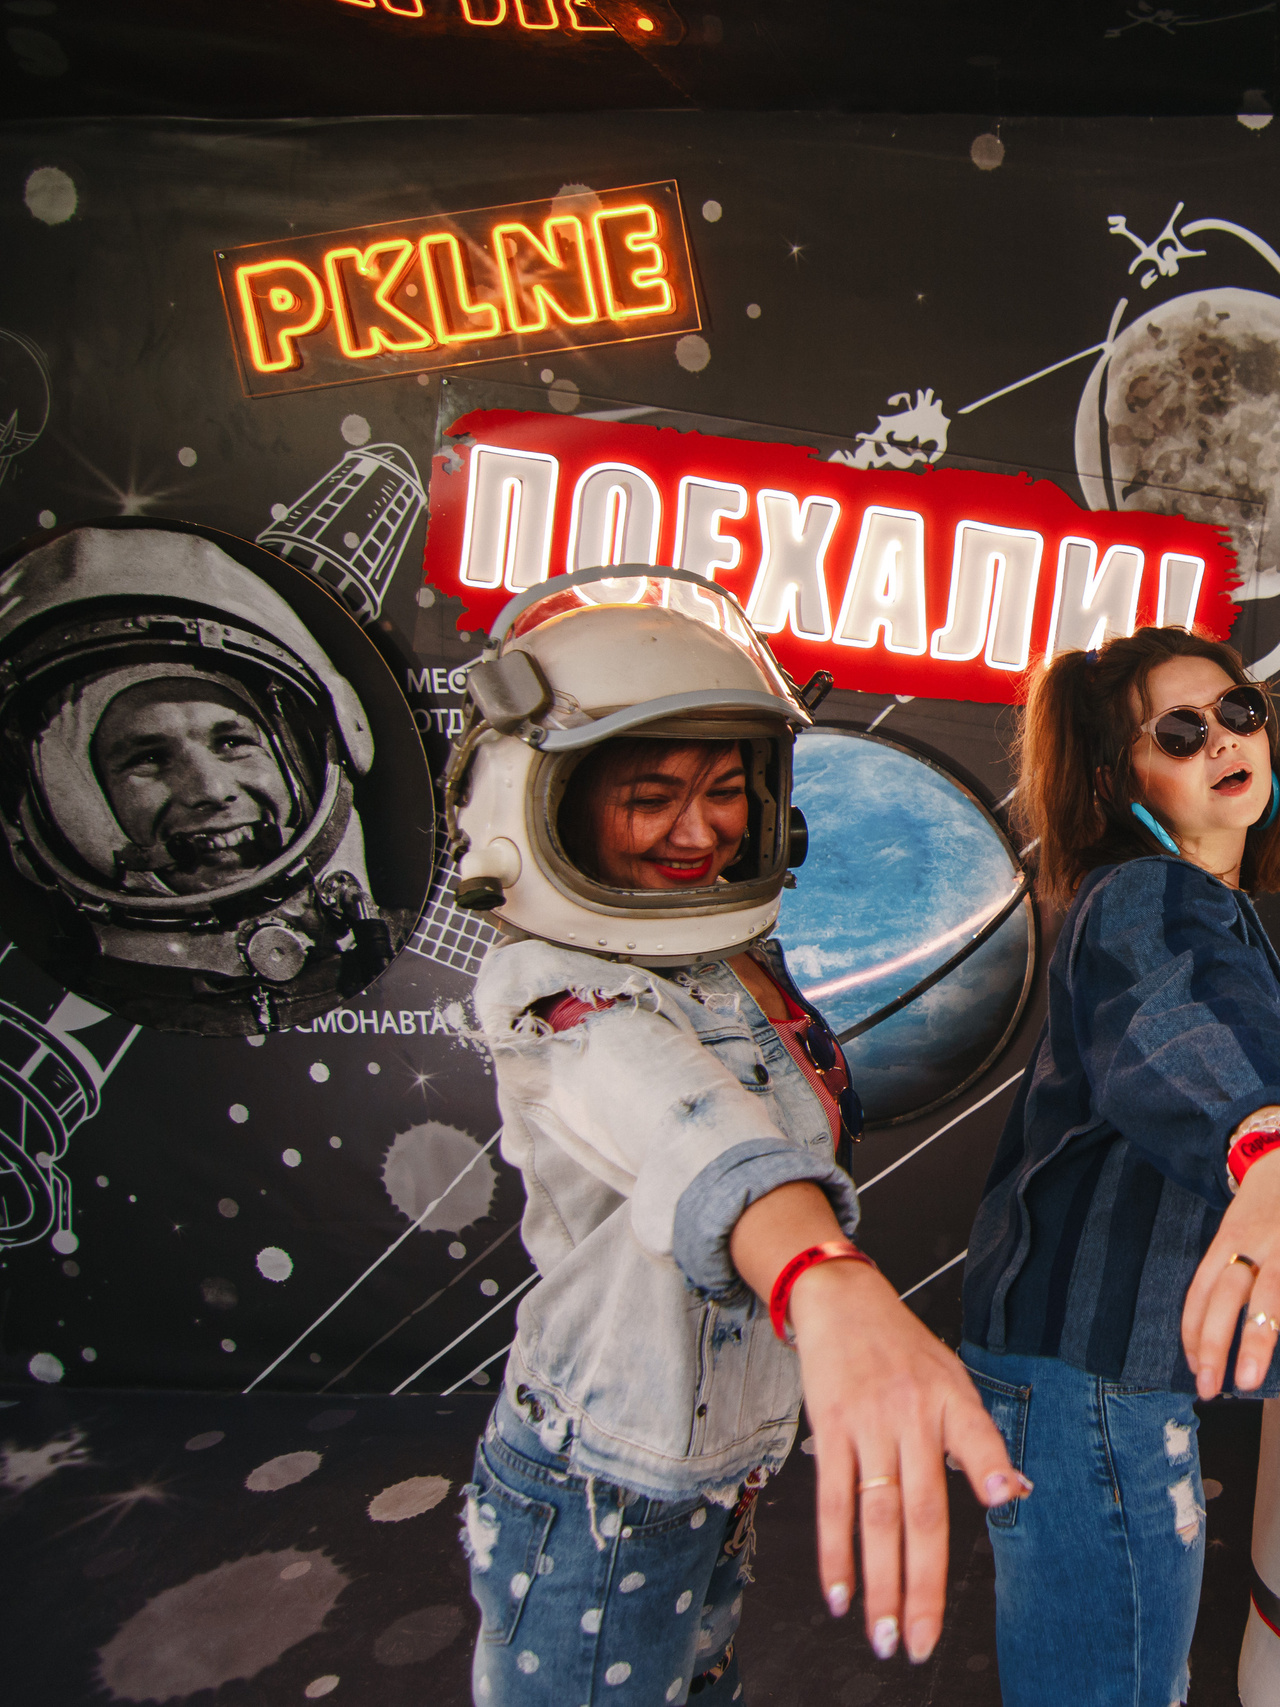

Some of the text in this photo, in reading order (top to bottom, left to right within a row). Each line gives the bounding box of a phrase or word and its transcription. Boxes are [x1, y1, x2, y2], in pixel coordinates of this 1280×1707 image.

[237, 204, 674, 373] PKLNE
[459, 443, 1207, 673] ПОЕХАЛИ!
[406, 667, 471, 694] МЕС
